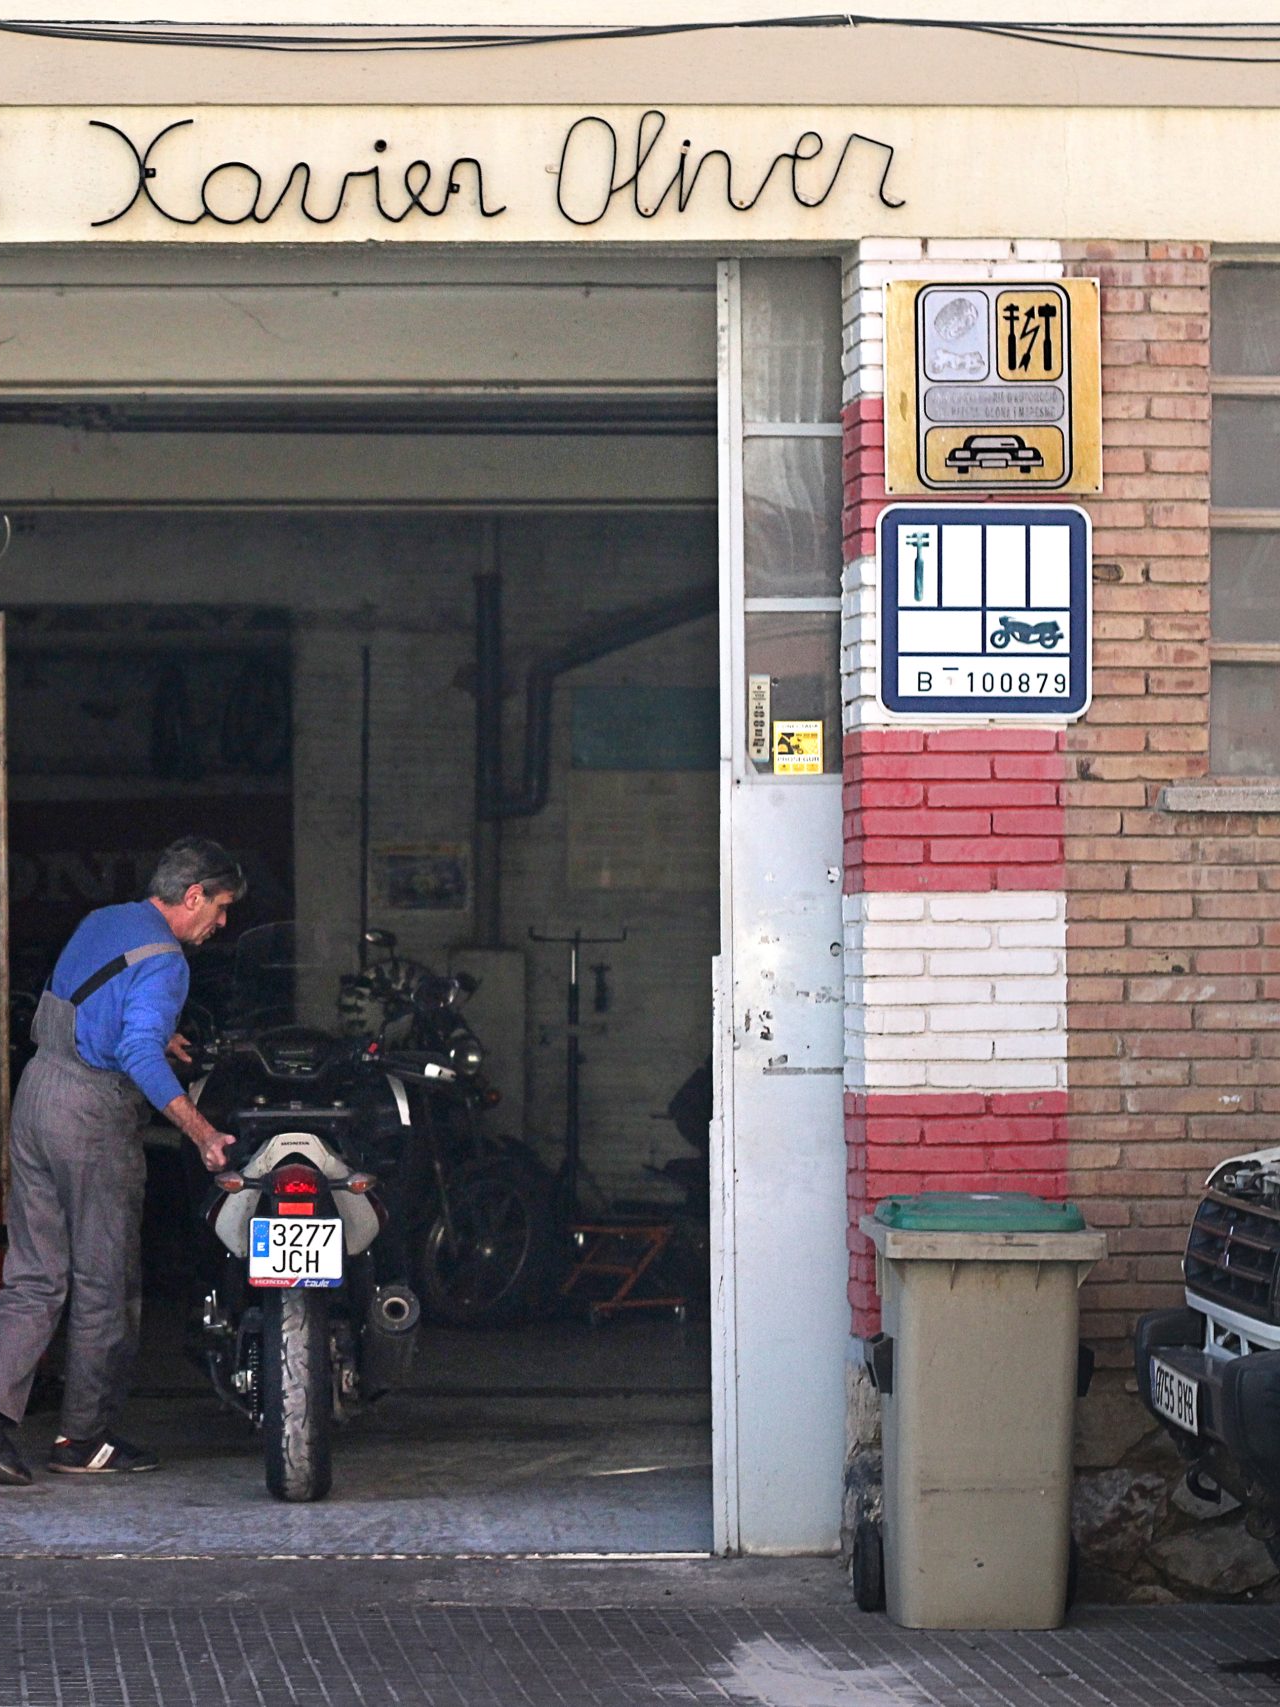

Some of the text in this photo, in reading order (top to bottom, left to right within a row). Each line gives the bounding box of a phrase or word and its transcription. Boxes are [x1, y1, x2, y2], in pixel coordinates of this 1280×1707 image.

[88, 118, 507, 226] Xavier
[556, 109, 907, 225] Oliver
[257, 1242, 266, 1252] E
[272, 1223, 337, 1248] 3277
[272, 1249, 320, 1274] JCH
[254, 1278, 290, 1286] HONDA
